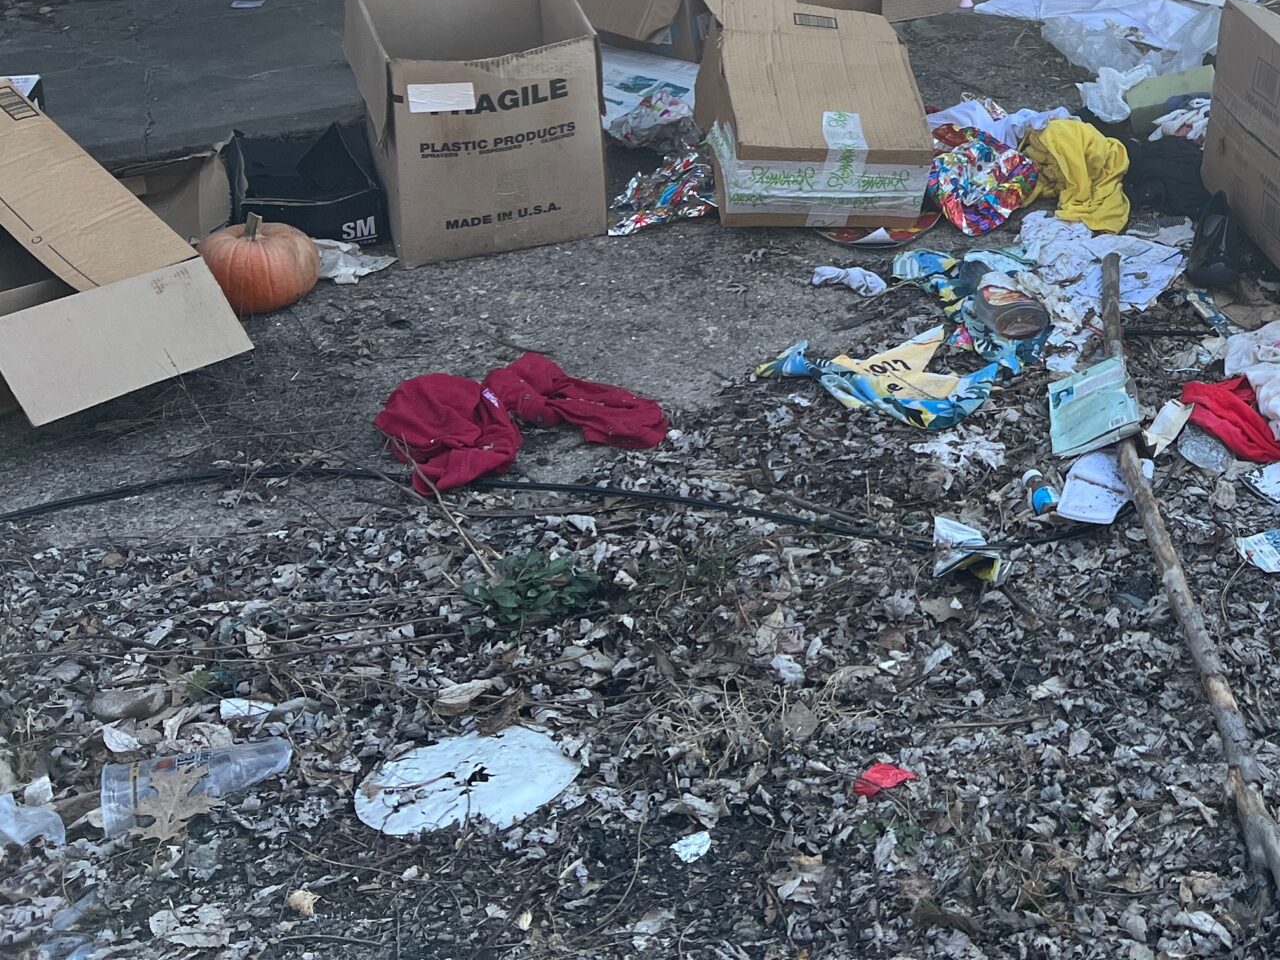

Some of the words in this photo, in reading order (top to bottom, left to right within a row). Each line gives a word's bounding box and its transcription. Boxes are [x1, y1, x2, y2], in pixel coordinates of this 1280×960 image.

[430, 78, 568, 115] AGILE
[420, 139, 490, 153] PLASTIC
[493, 122, 576, 148] PRODUCTS
[751, 166, 816, 190] JOURNEYS
[856, 168, 911, 192] JOURNEY
[342, 216, 376, 240] SM
[445, 214, 493, 230] MADE
[497, 210, 513, 222] IN
[518, 202, 562, 218] U.S.A.
[863, 359, 912, 374] 017
